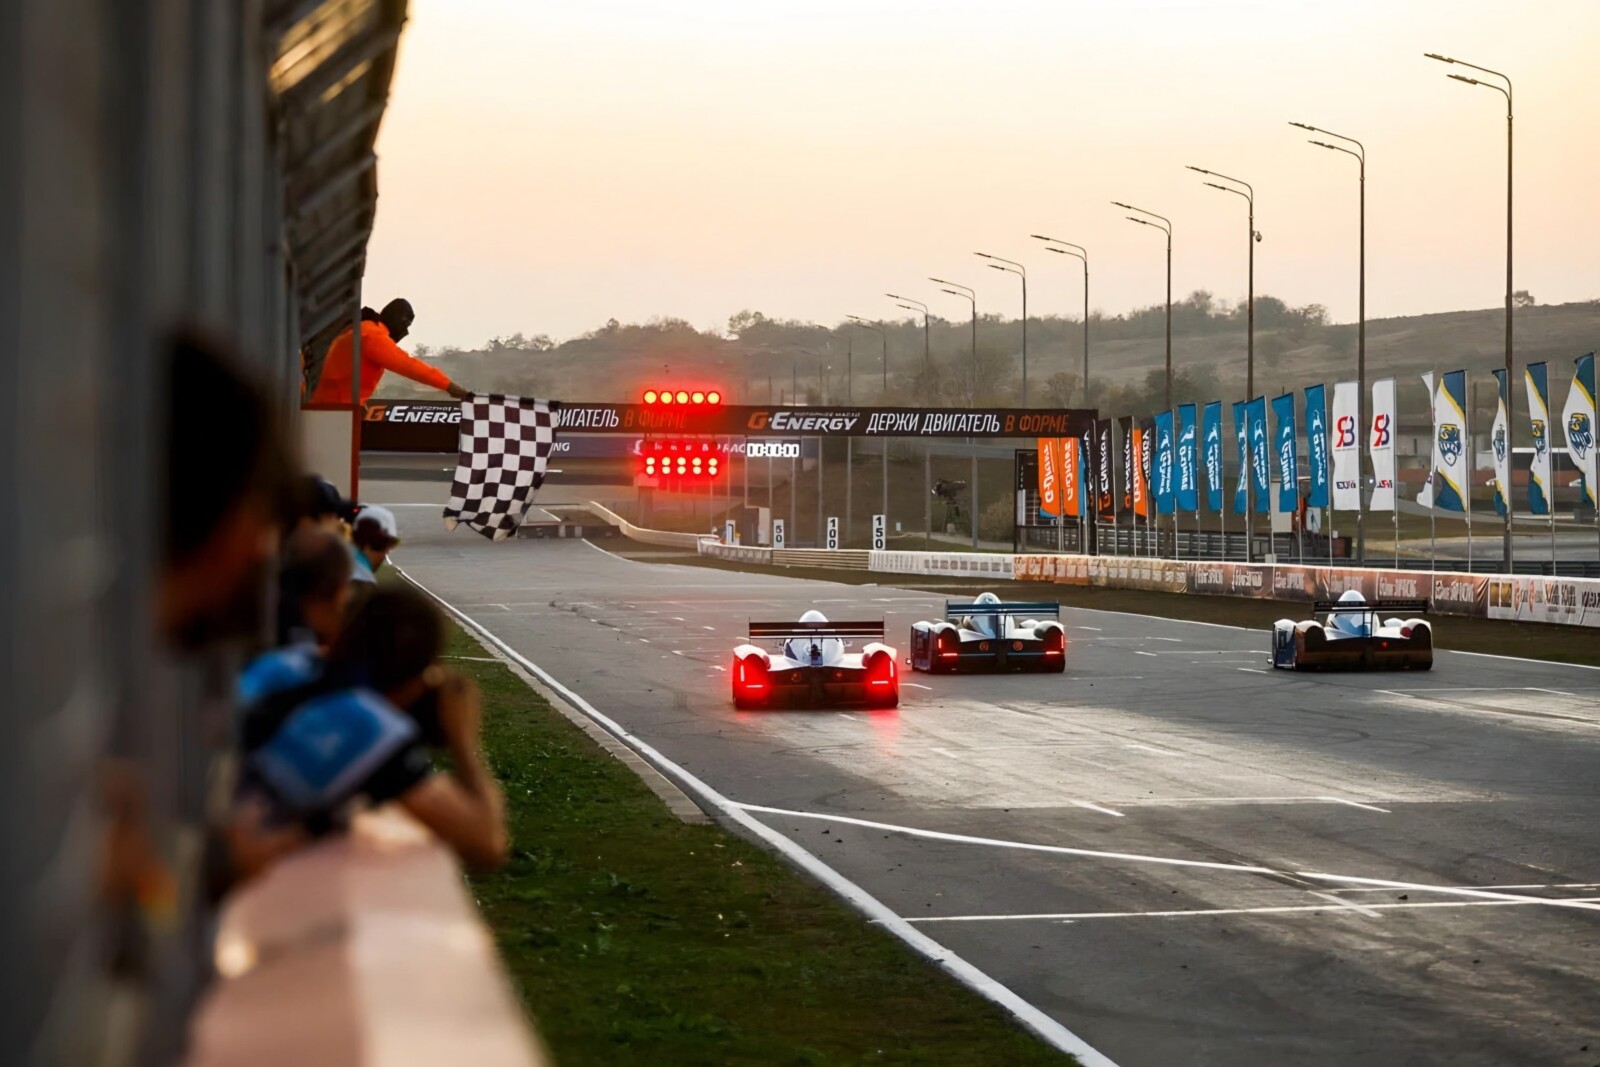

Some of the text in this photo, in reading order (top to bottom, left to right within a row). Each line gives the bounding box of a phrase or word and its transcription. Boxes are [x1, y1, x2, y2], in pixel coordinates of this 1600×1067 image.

[365, 405, 462, 424] G-ENERG
[866, 412, 1069, 435] ДЕРЖИ ДВИГАТЕЛЬ В ФОРМЕ
[775, 525, 783, 543] 50
[828, 518, 837, 549] 100
[875, 516, 884, 549] 150
